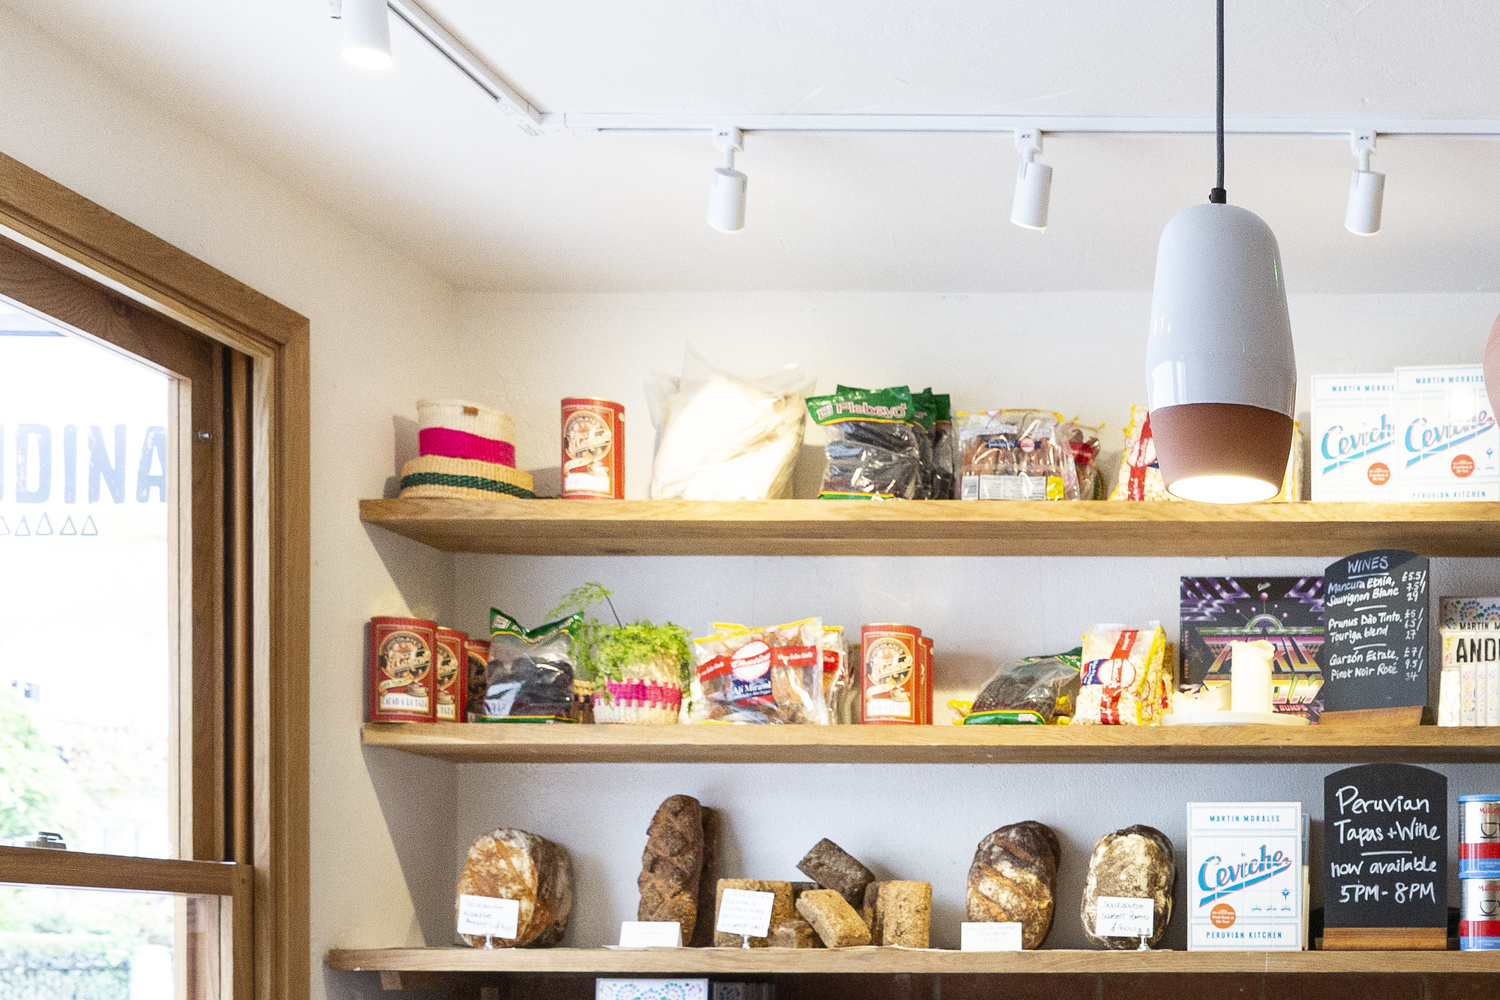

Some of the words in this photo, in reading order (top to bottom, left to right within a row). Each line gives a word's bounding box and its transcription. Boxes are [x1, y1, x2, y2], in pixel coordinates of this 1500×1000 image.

[1321, 414, 1395, 459] Cevich
[1348, 556, 1388, 573] WINES
[1328, 580, 1365, 594] Mancura
[1407, 591, 1418, 602] 29
[1327, 593, 1369, 607] Sauvignon
[1372, 587, 1399, 599] Blanc
[1329, 618, 1358, 630] Prunus
[1459, 622, 1489, 631] MARTIN
[1330, 630, 1362, 644] Touriga
[1364, 625, 1388, 638] blend
[1329, 651, 1363, 666] Garzón
[1331, 669, 1353, 682] Pinot
[1355, 667, 1375, 677] Noir
[1377, 662, 1398, 675] Rosé
[1336, 786, 1430, 815] Peruvian
[1334, 819, 1384, 846] Tapas
[1198, 845, 1292, 891] Ceviche
[1331, 861, 1364, 878] now
[1370, 856, 1437, 874] available
[1206, 931, 1244, 939] PERUVIAN
[1249, 931, 1282, 939] KITCHEN
